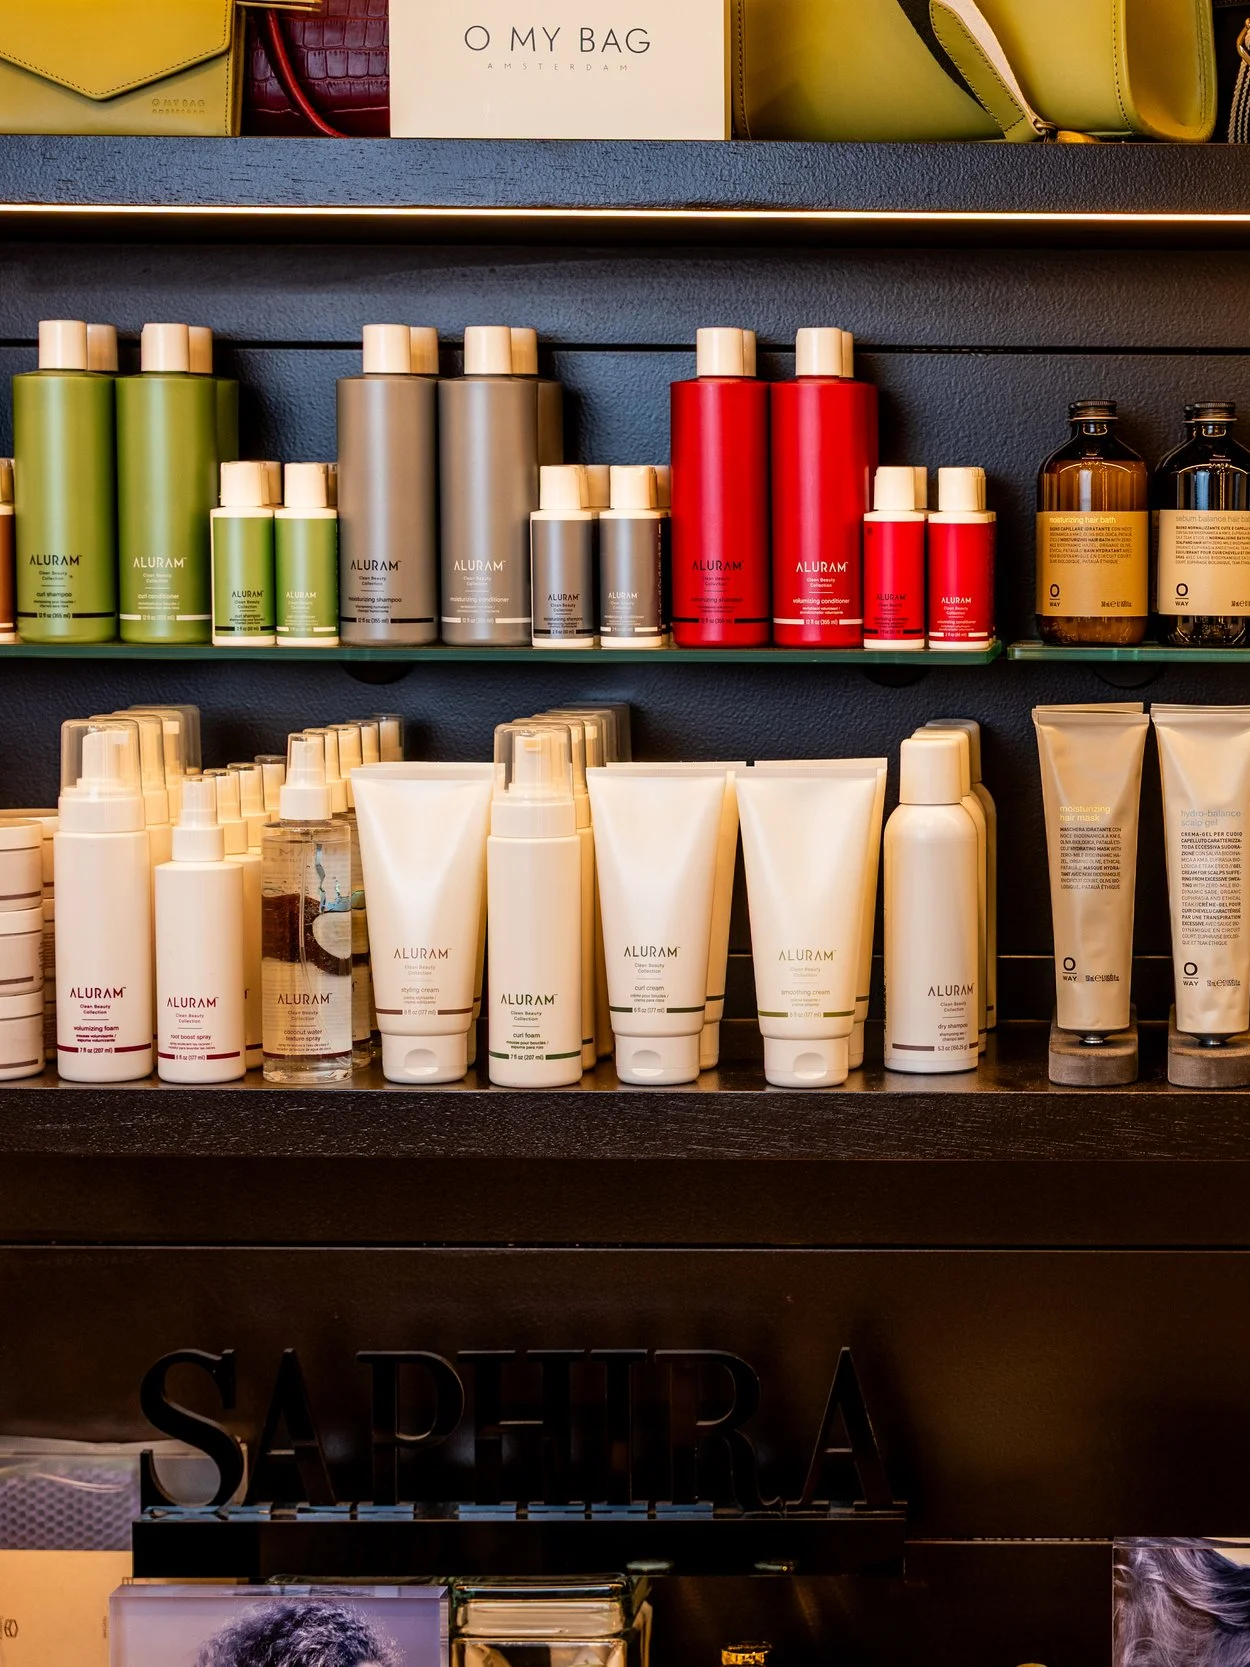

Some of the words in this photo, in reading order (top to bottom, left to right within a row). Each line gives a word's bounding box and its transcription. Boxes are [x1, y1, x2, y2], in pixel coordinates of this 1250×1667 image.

[465, 25, 490, 51] O
[511, 27, 560, 52] MY
[580, 27, 650, 53] BAG
[488, 63, 627, 71] AMSTERDAM
[30, 555, 79, 566] ALURAM
[134, 557, 184, 568] ALURAM
[351, 560, 398, 571] ALURAM
[454, 560, 503, 571] ALURAM
[692, 561, 742, 571] ALURAM
[796, 562, 846, 572] ALURAM
[232, 590, 262, 598] ALURAM
[1050, 584, 1060, 597] O
[1176, 583, 1188, 596] O
[1059, 806, 1111, 814] moisturizing
[1181, 810, 1241, 819] hydro-balance
[1060, 814, 1076, 822] hair
[1181, 819, 1203, 827] scalp
[1204, 819, 1218, 827] gel
[393, 948, 449, 959] ALURAM
[623, 946, 678, 958] ALURAM
[778, 950, 834, 961] ALURAM
[1063, 957, 1076, 971] O
[1184, 962, 1198, 976] O
[70, 988, 124, 998] ALURAM
[401, 986, 419, 994] styling
[928, 985, 974, 996] ALURAM
[167, 997, 216, 1008] ALURAM
[277, 994, 330, 1004] ALURAM
[501, 994, 555, 1006] ALURAM
[139, 1345, 908, 1517] SAPHIRA
